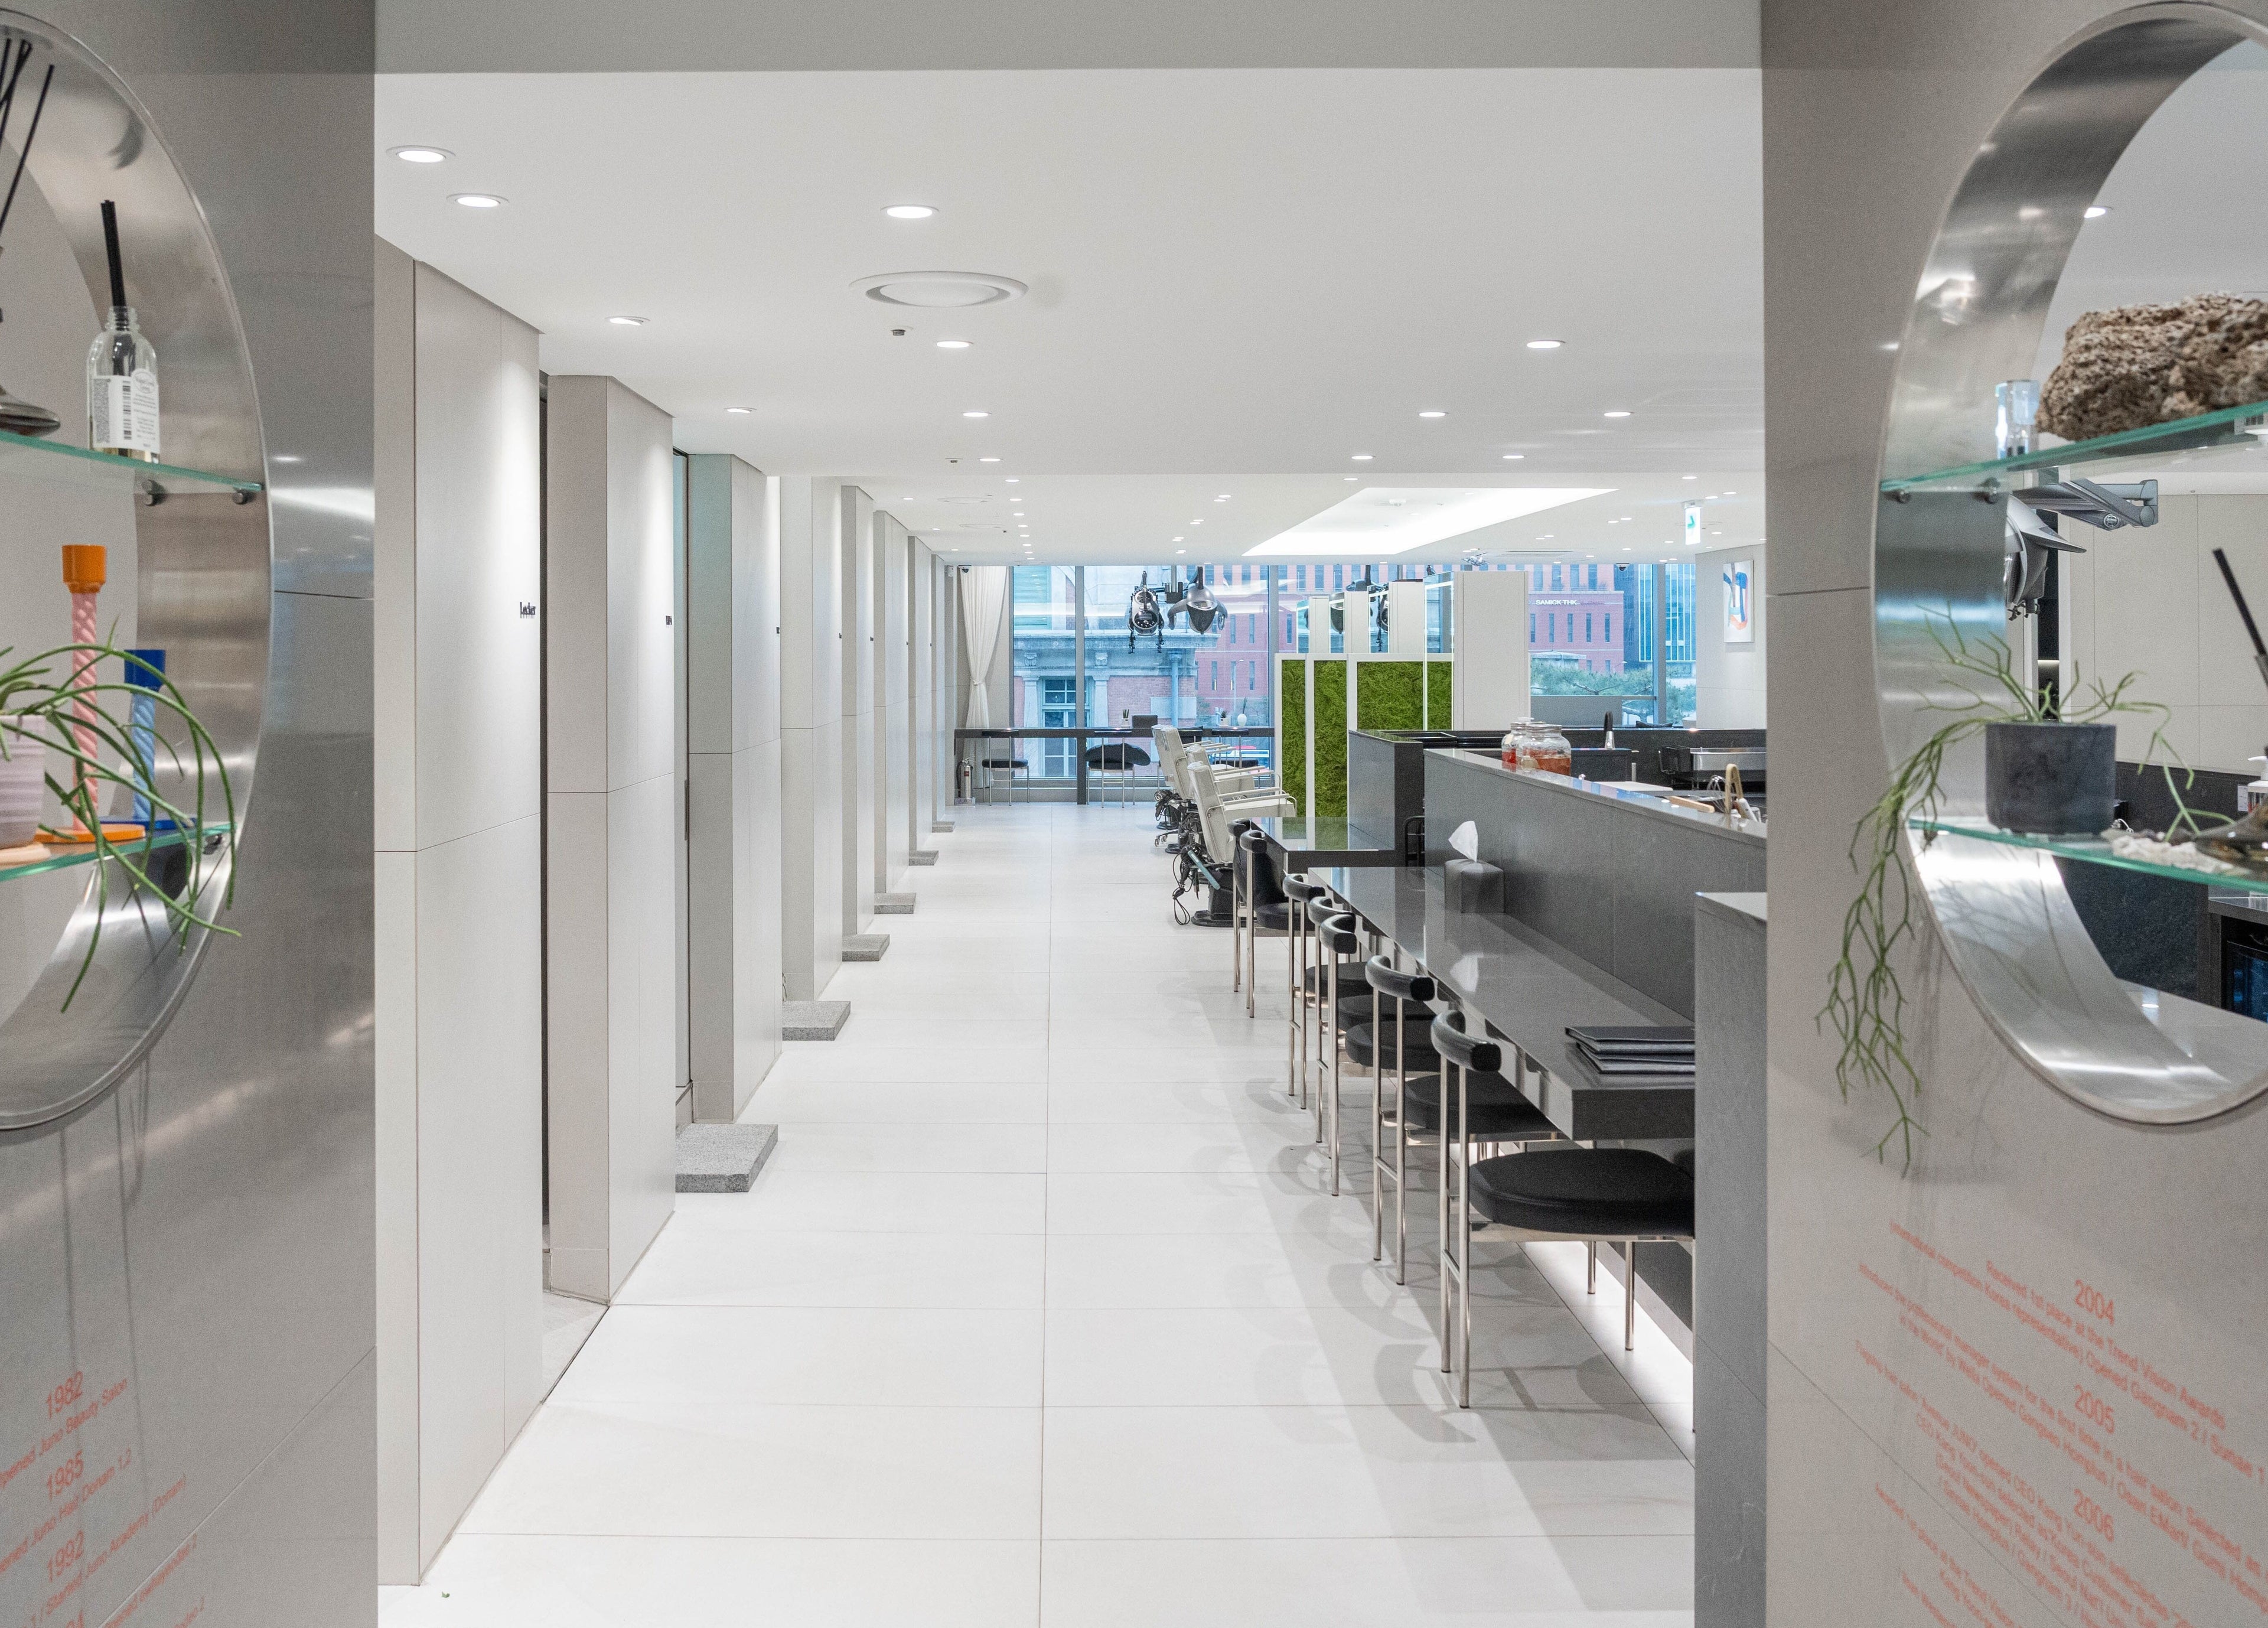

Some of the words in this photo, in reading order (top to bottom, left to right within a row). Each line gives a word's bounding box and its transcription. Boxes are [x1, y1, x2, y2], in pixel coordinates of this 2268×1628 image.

[2074, 1279, 2115, 1326] 2004
[46, 1370, 83, 1418] 1982
[2074, 1383, 2115, 1435] 2005
[46, 1450, 84, 1499] 1985
[2073, 1488, 2114, 1543] 2006
[47, 1529, 84, 1583] 1992
